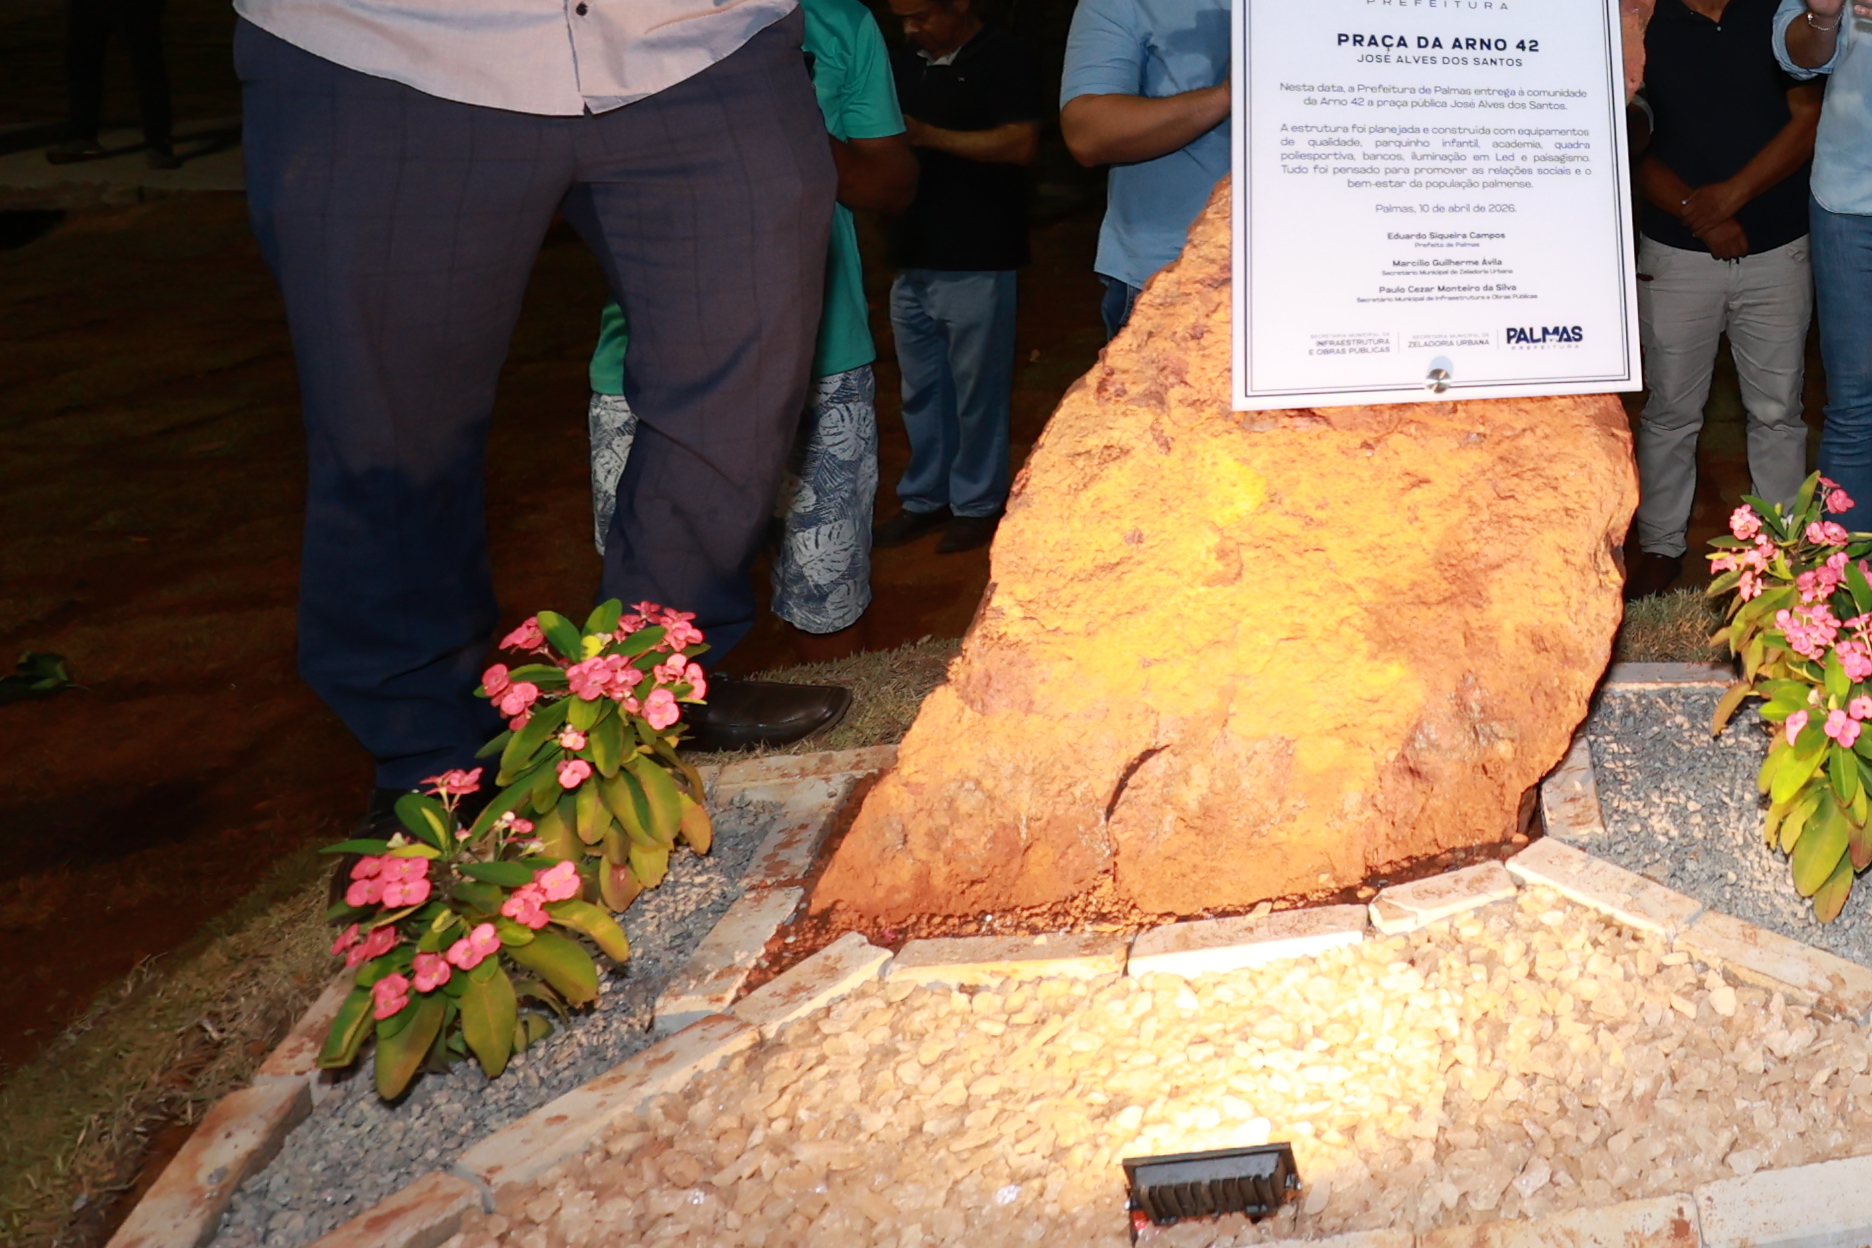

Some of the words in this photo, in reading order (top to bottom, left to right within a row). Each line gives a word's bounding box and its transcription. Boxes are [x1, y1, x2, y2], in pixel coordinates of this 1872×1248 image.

[1337, 33, 1408, 53] PRAÇA
[1417, 36, 1443, 49] DA
[1451, 37, 1507, 51] ARNO
[1516, 39, 1539, 52] 42
[1357, 52, 1391, 63] JOSÉ
[1396, 55, 1437, 64] ALVES
[1442, 56, 1468, 65] DOS
[1473, 57, 1522, 67] SANTOS
[1280, 82, 1315, 92] Nesta
[1317, 83, 1346, 93] data,
[1357, 84, 1416, 94] Prefeitura
[1418, 85, 1432, 94] de
[1434, 86, 1472, 95] Palmas
[1474, 88, 1516, 98] entrega
[1527, 89, 1587, 98] comunidade
[1303, 96, 1318, 105] da
[1320, 97, 1348, 106] Arno
[1350, 97, 1364, 106] 42
[1376, 100, 1408, 109] praça
[1411, 98, 1447, 109] pública
[1450, 99, 1475, 108] José
[1478, 100, 1505, 109] Alves
[1507, 100, 1527, 109] dos
[1280, 123, 1289, 132] A
[1290, 124, 1349, 133] estrutura
[1351, 124, 1366, 133] foi
[1368, 124, 1421, 136] planejada
[1518, 127, 1589, 137] equipamentos
[1280, 137, 1295, 146] de
[1375, 138, 1430, 149] parquinho
[1554, 140, 1590, 150] quadra
[1281, 150, 1356, 162] poliesportiva,
[1362, 151, 1405, 161] bancos,
[1411, 151, 1467, 163] iluminação
[1495, 153, 1515, 162] Led
[1533, 153, 1591, 164] paisagismo.
[1281, 164, 1309, 174] Tudo
[1313, 164, 1328, 174] foi
[1333, 165, 1380, 176] pensado
[1384, 167, 1410, 176] para
[1414, 167, 1468, 176] promover
[1488, 166, 1533, 177] relações
[1537, 166, 1571, 175] sociais
[1347, 179, 1407, 188] bem-estar
[1409, 179, 1423, 188] da
[1425, 179, 1480, 190] população
[1482, 179, 1533, 190] palmense.
[1375, 204, 1416, 214] Palmas,
[1419, 204, 1430, 213] 10
[1432, 204, 1445, 213] de
[1448, 204, 1470, 213] abril
[1472, 204, 1486, 213] de
[1387, 232, 1427, 240] Eduardo
[1429, 232, 1467, 241] Siqueira
[1469, 232, 1506, 240] Campos
[1379, 286, 1406, 294] Paulo
[1408, 285, 1435, 293] Cezar
[1437, 284, 1480, 292] Monteiro
[1496, 283, 1517, 291] Silva
[1506, 325, 1584, 345] PALMAS
[1408, 340, 1455, 348] ZELADORIA
[1456, 339, 1490, 347] URBANA
